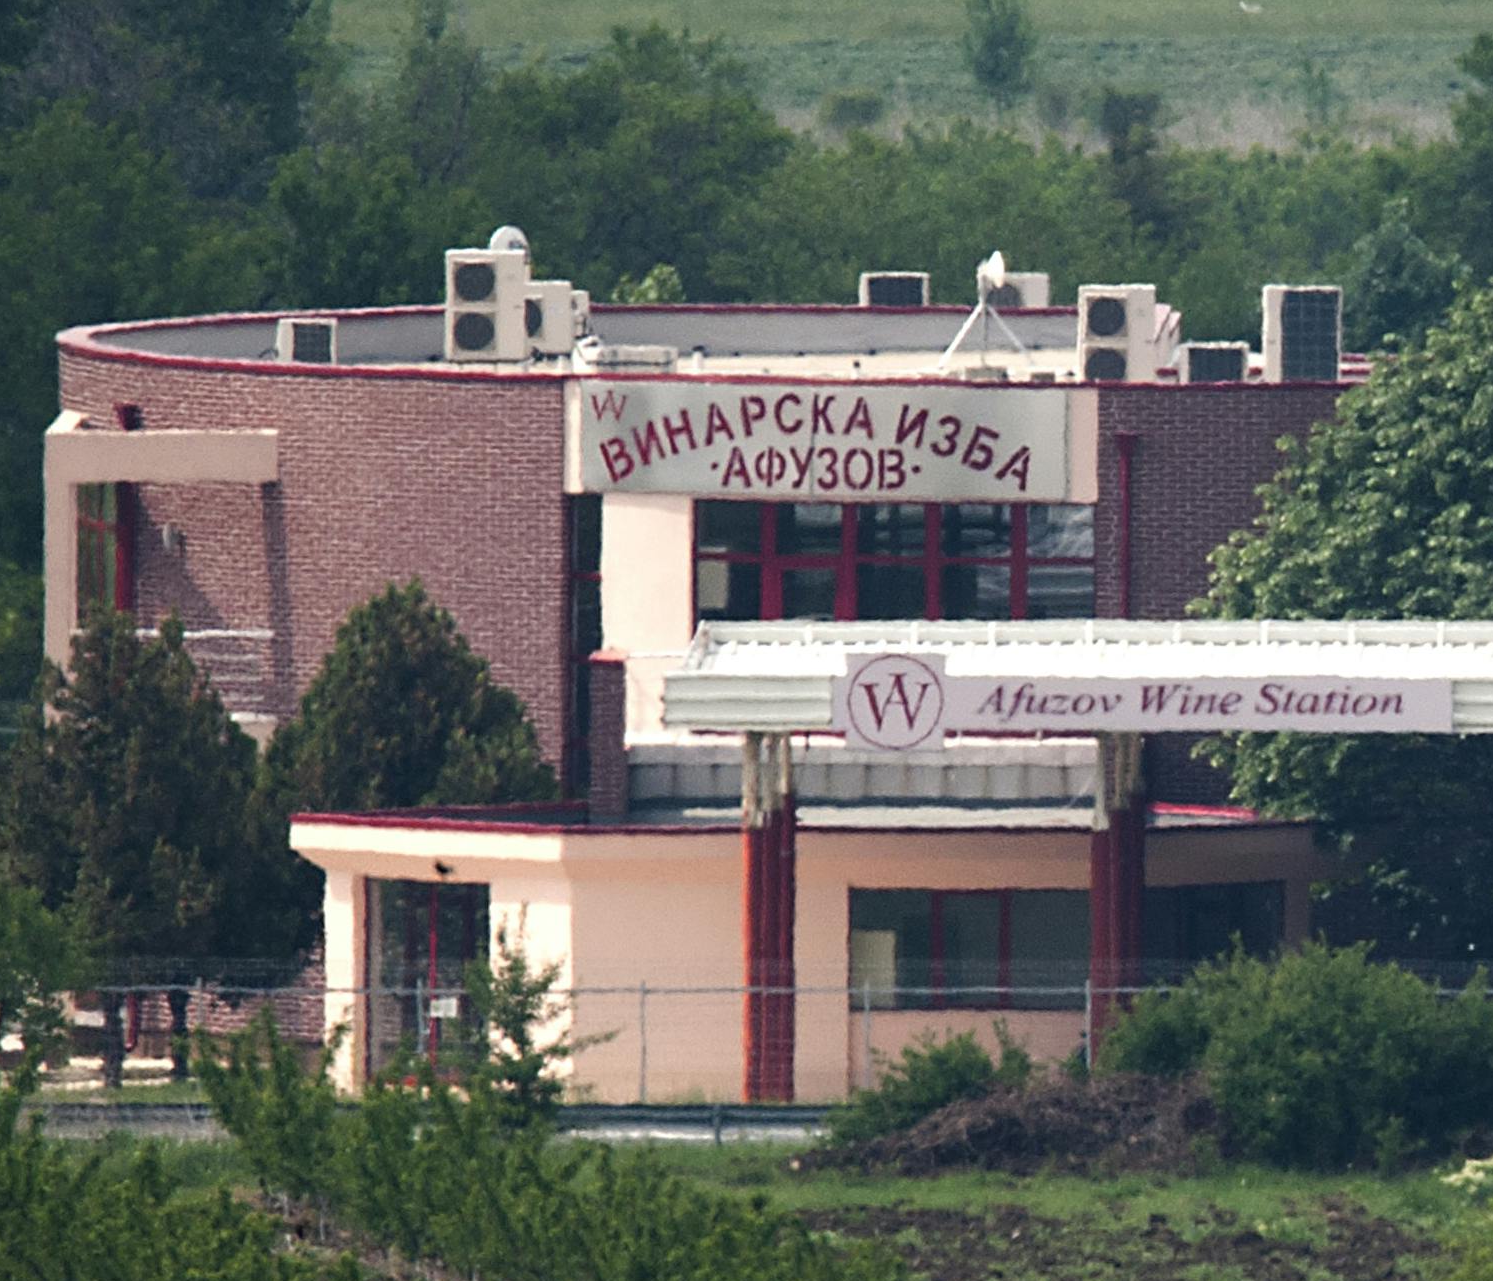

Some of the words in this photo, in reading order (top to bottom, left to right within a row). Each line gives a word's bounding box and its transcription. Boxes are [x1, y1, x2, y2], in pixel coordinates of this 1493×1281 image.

[599, 392, 874, 484] ВИНАРСКА
[894, 404, 1032, 491] ИЗБА
[977, 682, 1123, 723] Afuzov
[1139, 682, 1244, 717] Wine
[1254, 681, 1404, 716] Station
